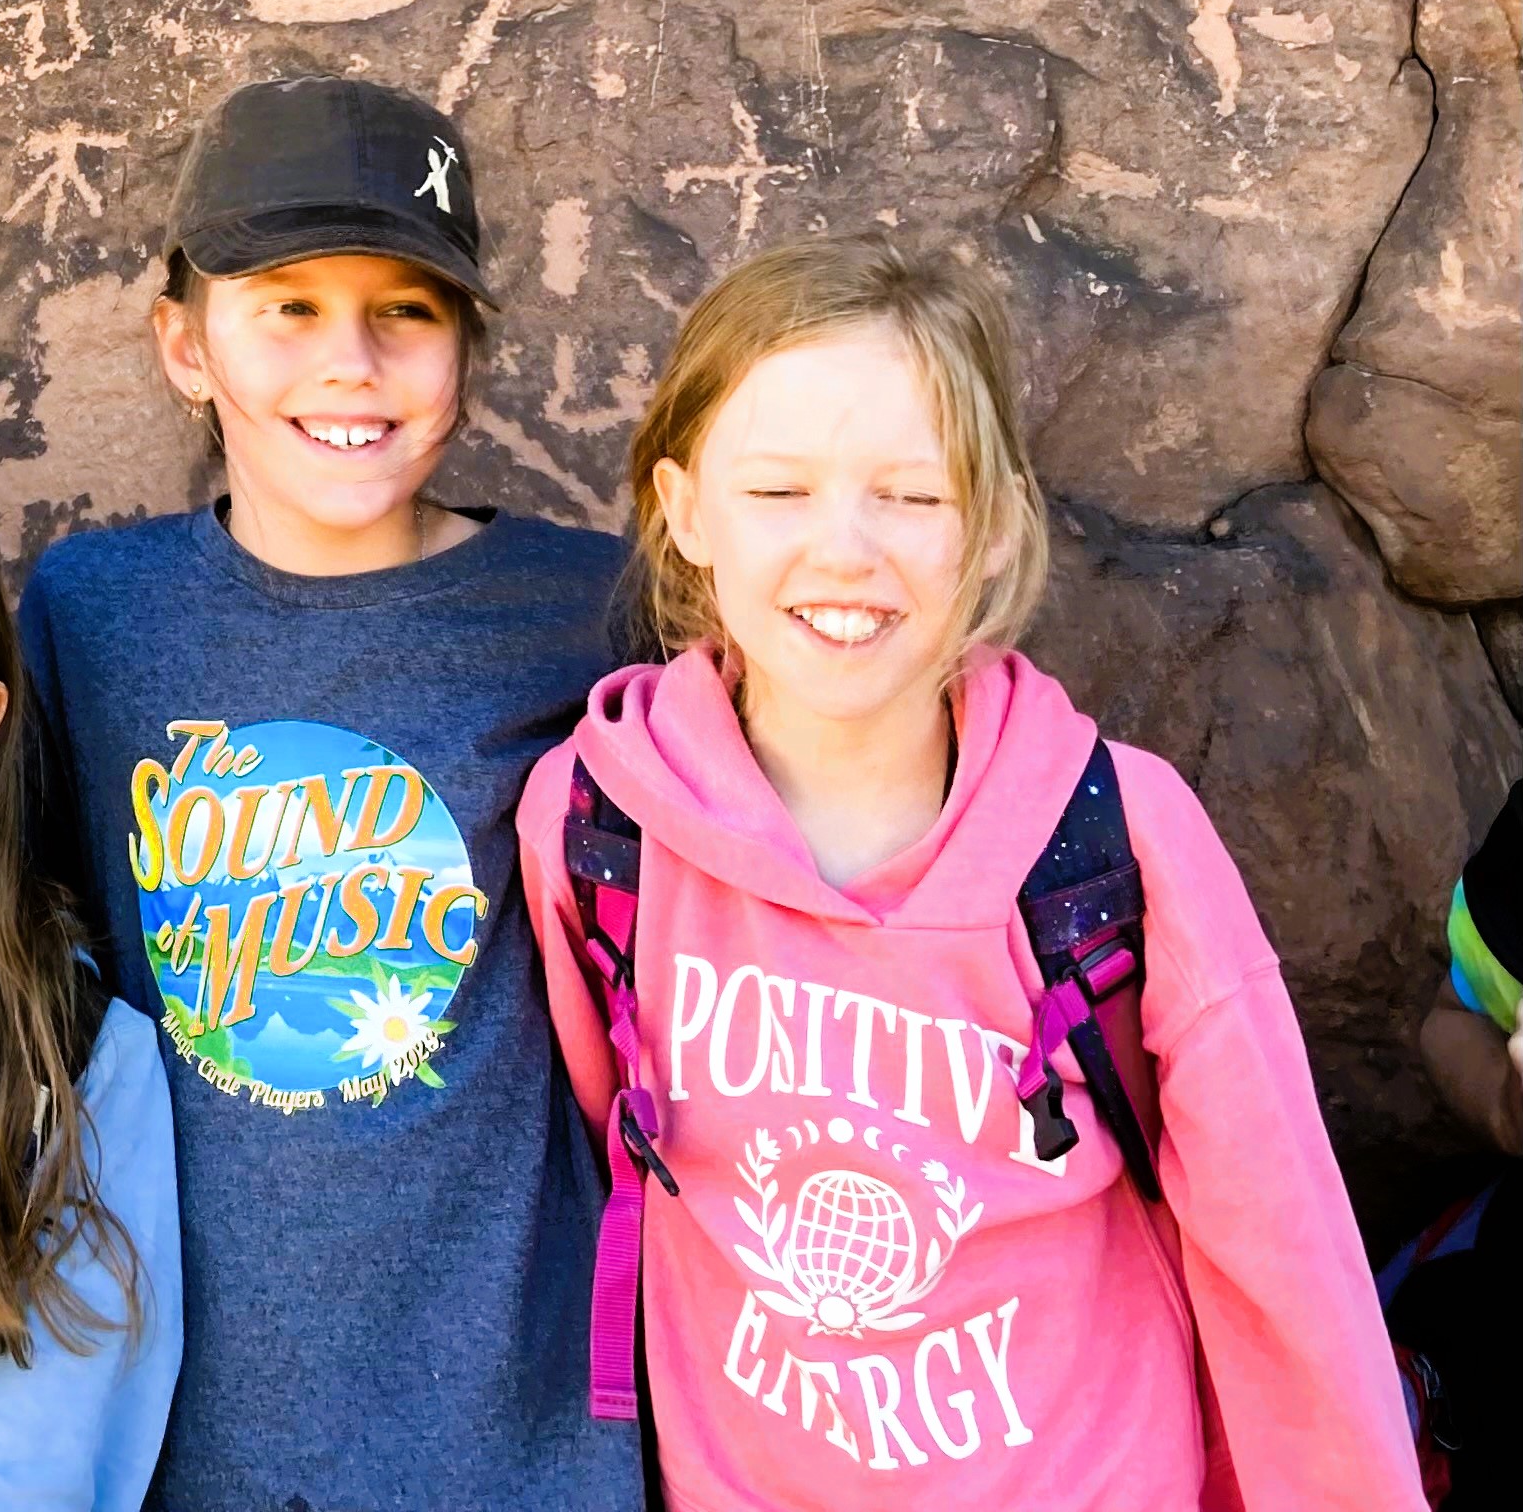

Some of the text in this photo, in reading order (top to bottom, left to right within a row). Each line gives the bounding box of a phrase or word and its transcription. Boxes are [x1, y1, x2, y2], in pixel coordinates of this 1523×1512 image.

[166, 720, 264, 783] The
[128, 758, 426, 892] SOUND
[156, 865, 490, 1038] of MUSIC
[160, 1009, 197, 1065] Magic
[198, 1056, 242, 1097] Circle
[248, 1080, 326, 1116] Players
[338, 1070, 388, 1104] May
[722, 1289, 1034, 1471] ENERGY
